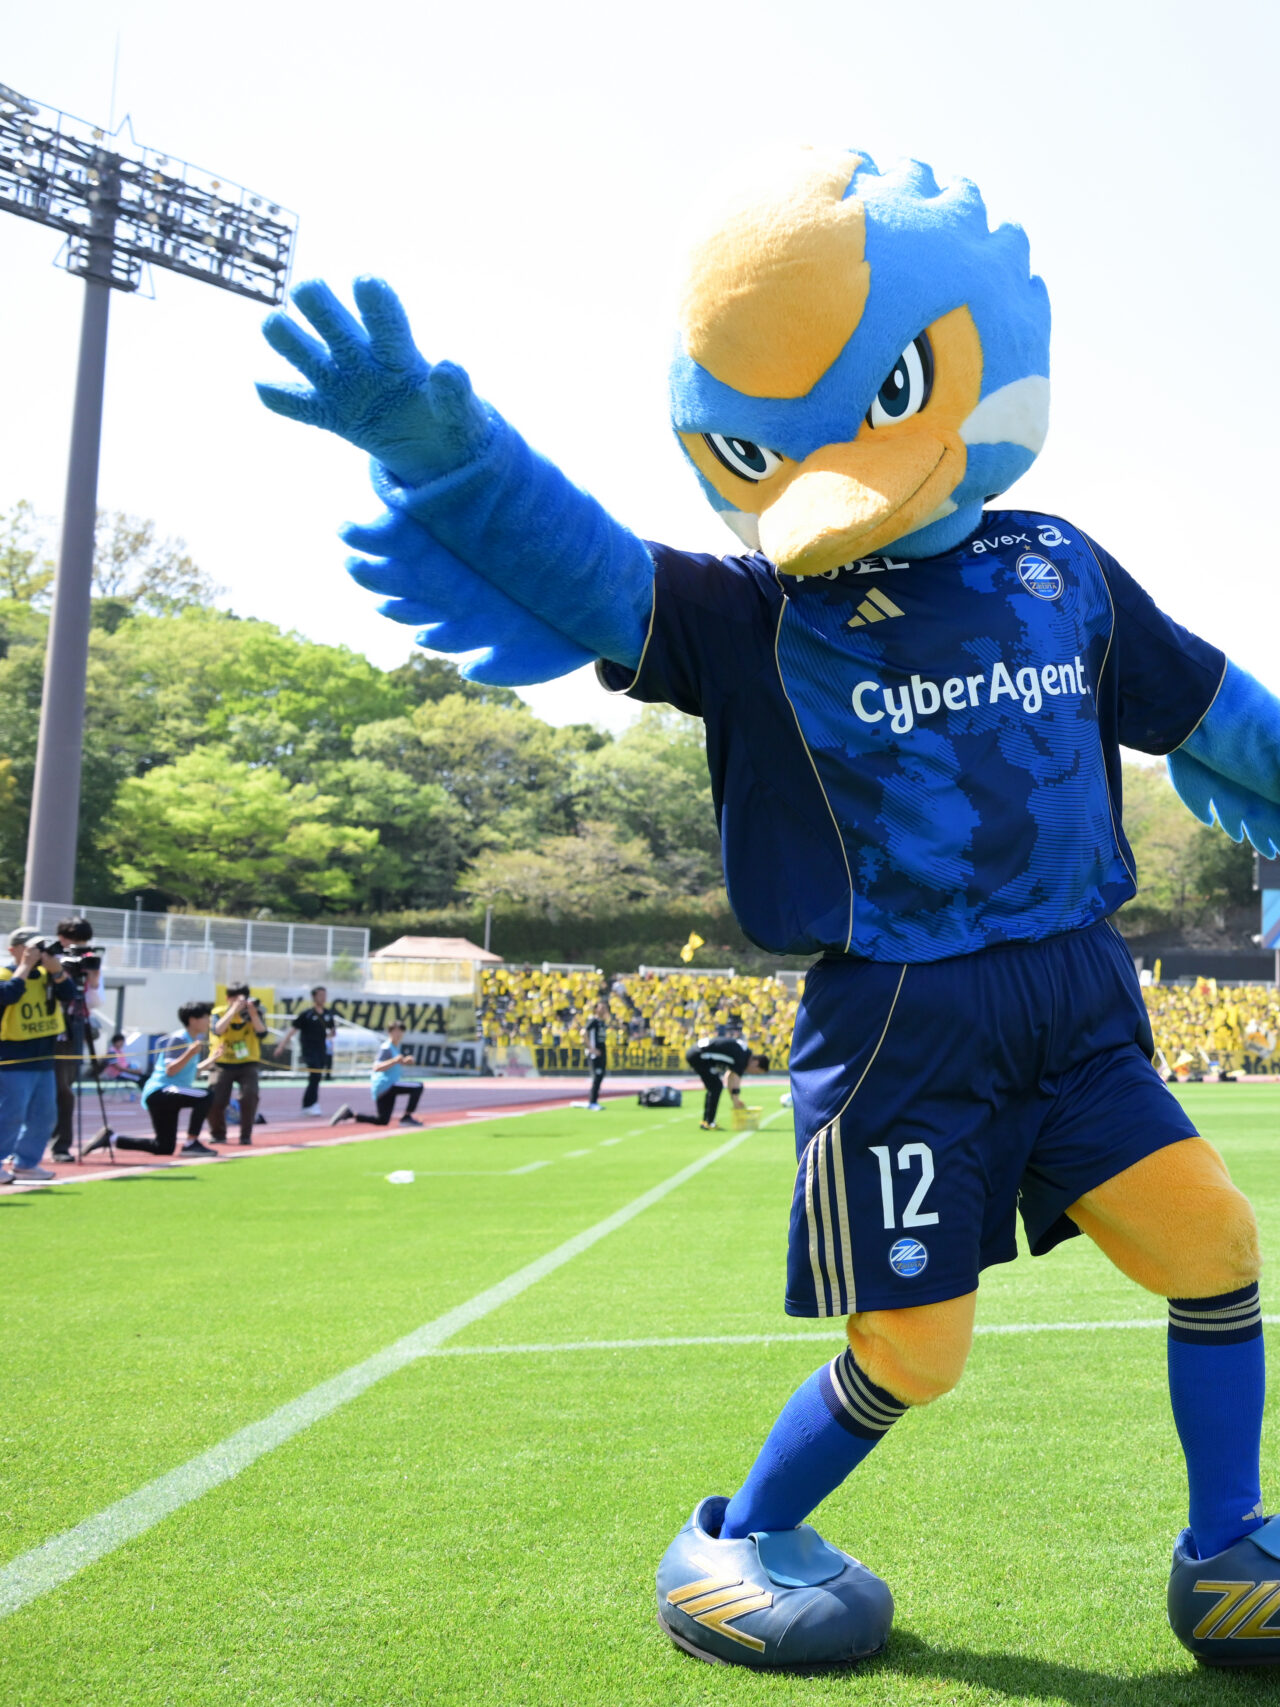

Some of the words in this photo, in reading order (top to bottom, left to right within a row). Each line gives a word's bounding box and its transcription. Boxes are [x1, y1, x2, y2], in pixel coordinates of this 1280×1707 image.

[972, 533, 1032, 553] avex
[279, 997, 447, 1034] KSHIWA
[868, 1142, 940, 1230] 12
